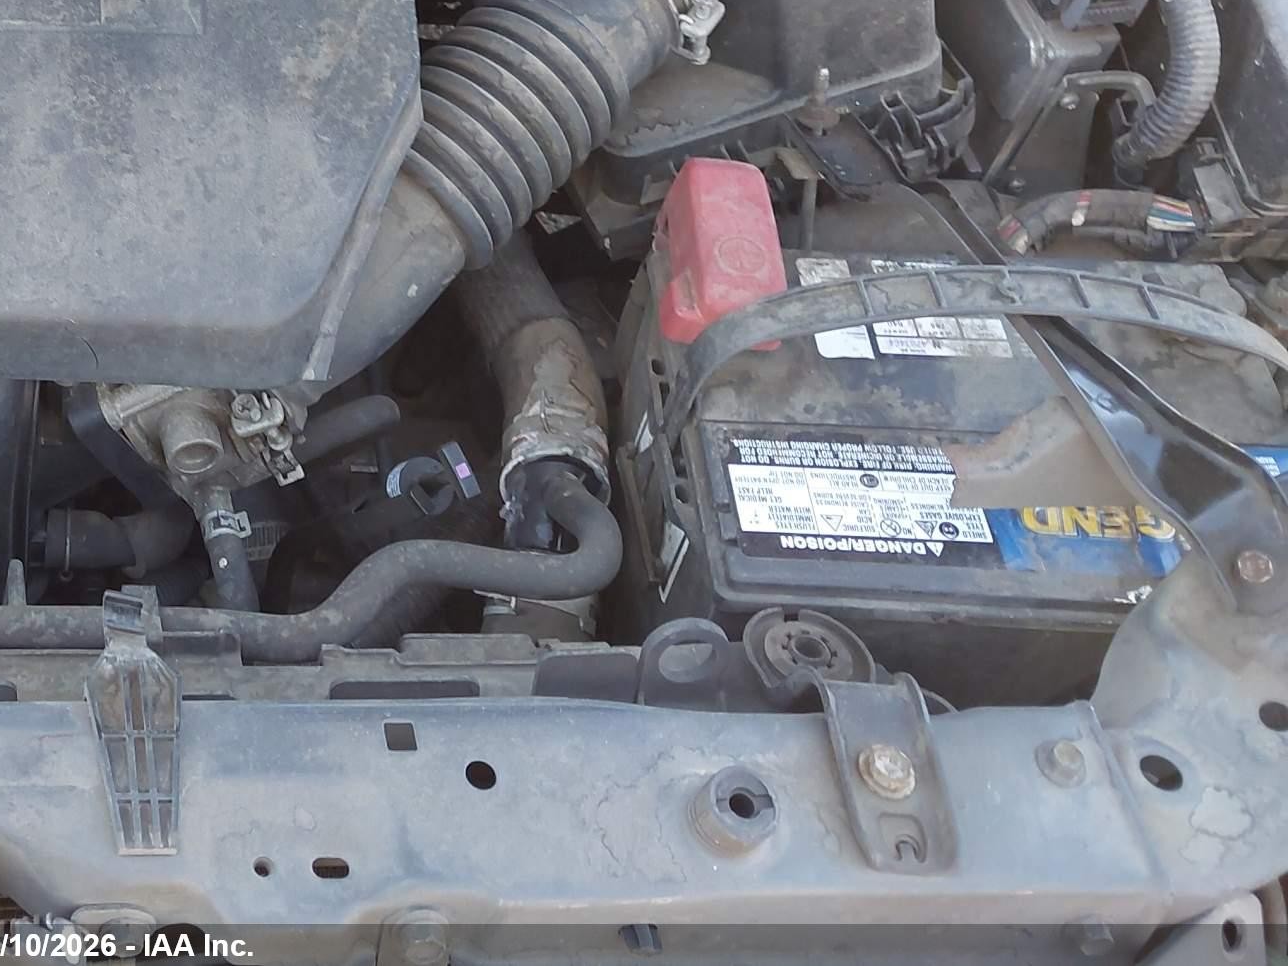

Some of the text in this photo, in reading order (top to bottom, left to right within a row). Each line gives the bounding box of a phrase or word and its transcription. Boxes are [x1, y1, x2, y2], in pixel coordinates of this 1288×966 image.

[790, 441, 830, 450] CHARGING
[831, 443, 862, 452] PROPER
[864, 444, 896, 453] FOLLOW
[739, 446, 756, 455] FOR
[740, 454, 757, 463] NOT
[757, 456, 770, 464] DO
[816, 458, 859, 468] EXPLOSION
[737, 487, 773, 495] HELP FAST
[737, 495, 782, 504] GET MEDICAL
[768, 506, 812, 514] WITH WATER
[768, 514, 813, 522] IMMEDIATELY
[856, 516, 872, 524] ACID
[919, 512, 982, 522] EXPLOSIVE GASES
[794, 522, 815, 531] FLUSH
[843, 524, 875, 533] SULFURIC
[902, 528, 912, 536] NO
[962, 531, 987, 539] SHIELD
[779, 535, 928, 555] DANGER/POISON
